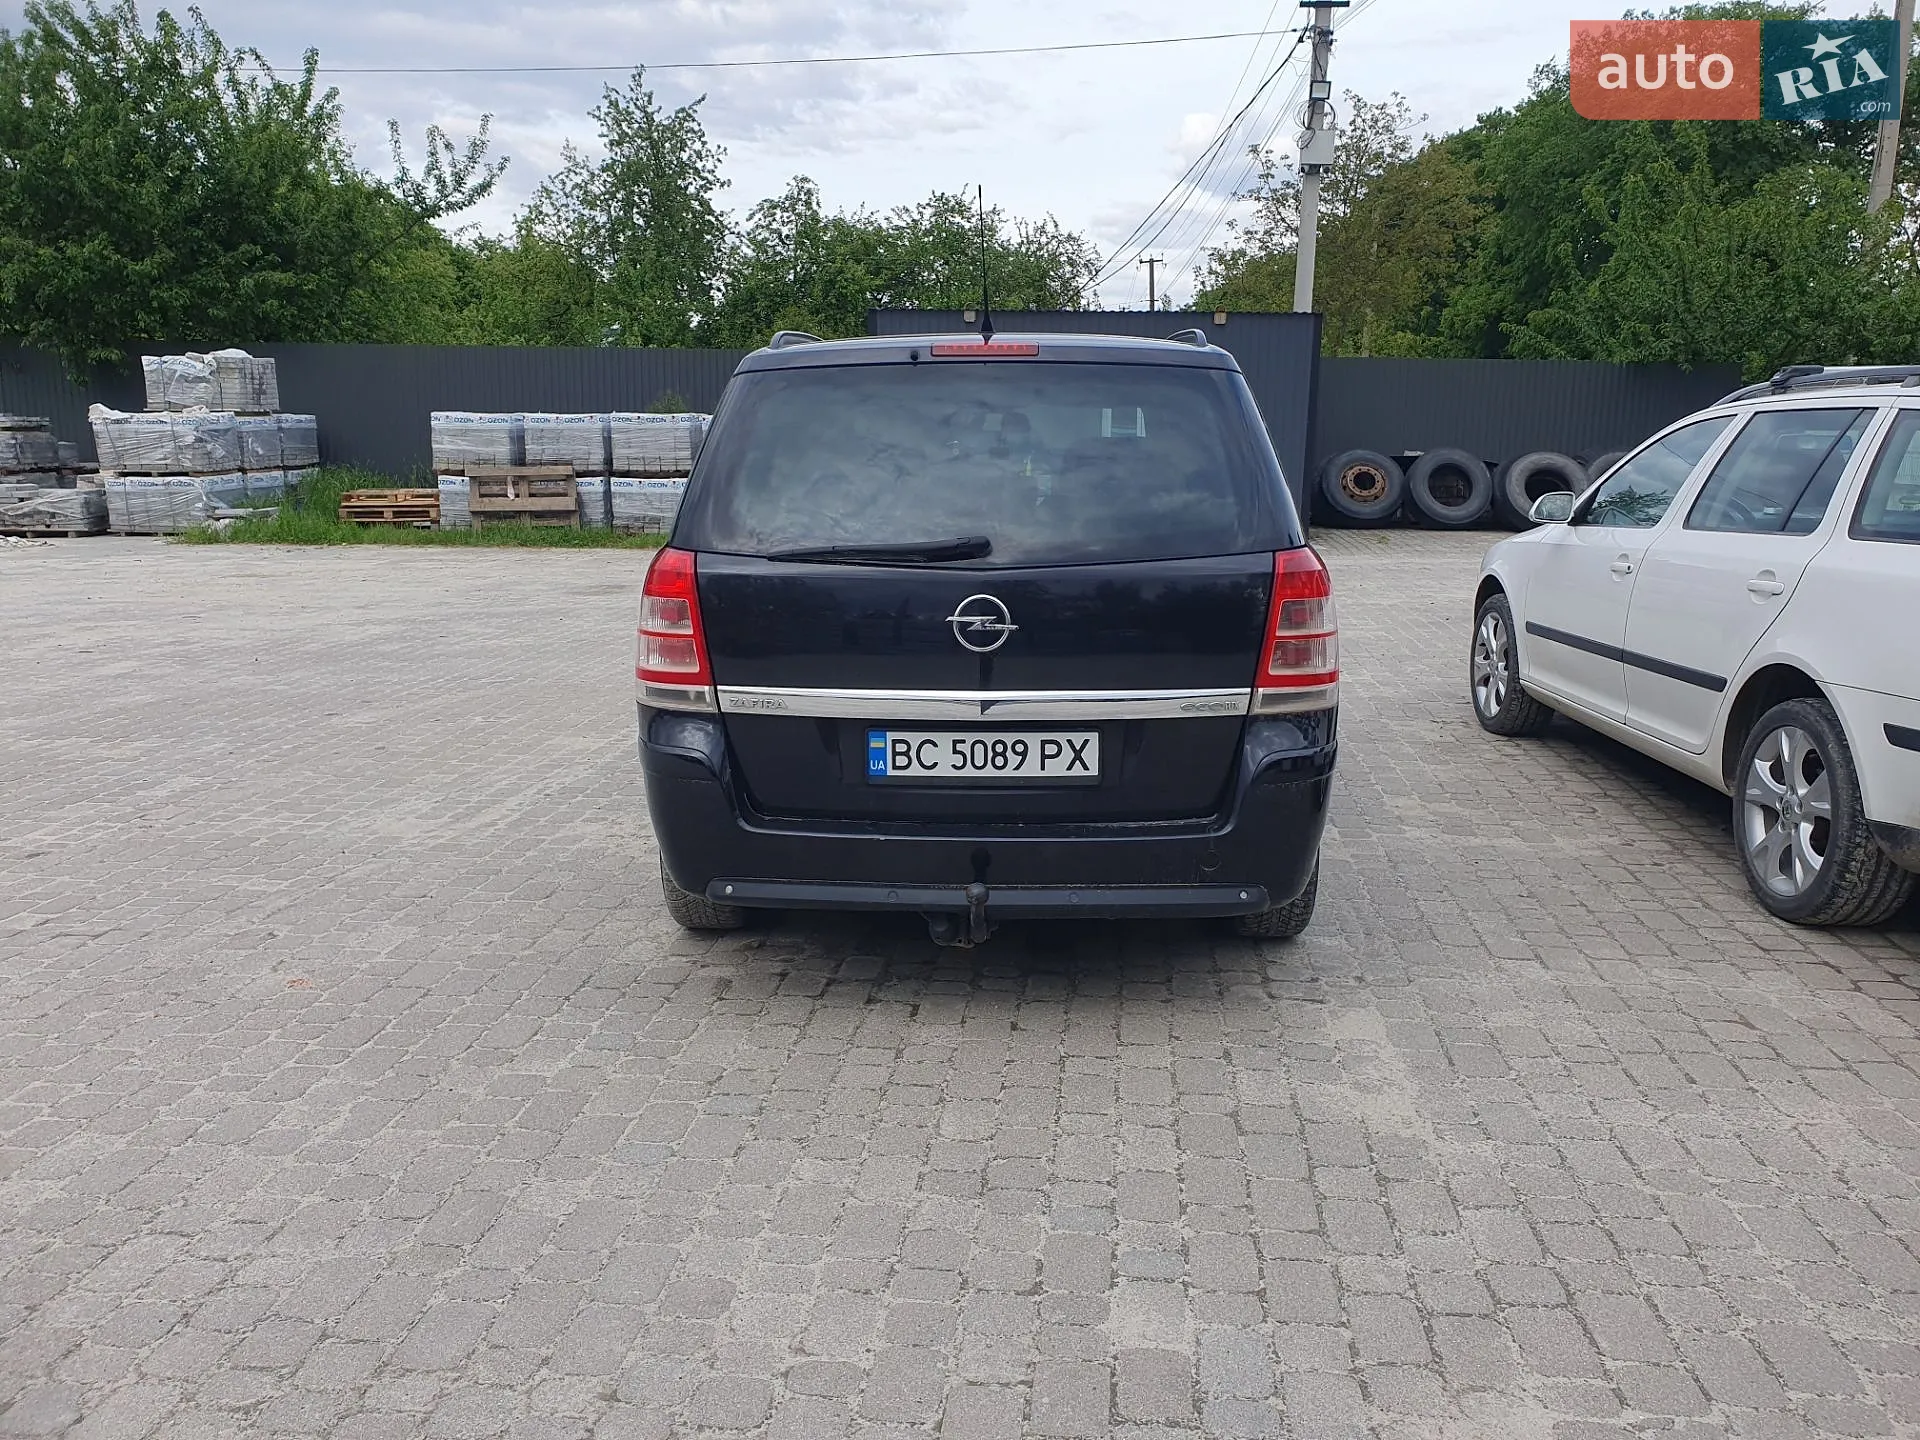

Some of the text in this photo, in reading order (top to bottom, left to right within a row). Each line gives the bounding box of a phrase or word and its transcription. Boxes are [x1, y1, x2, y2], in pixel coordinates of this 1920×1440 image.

[729, 696, 789, 710] ZAFIRA
[891, 738, 1091, 772] BC 5089 PX
[870, 761, 885, 770] UA
